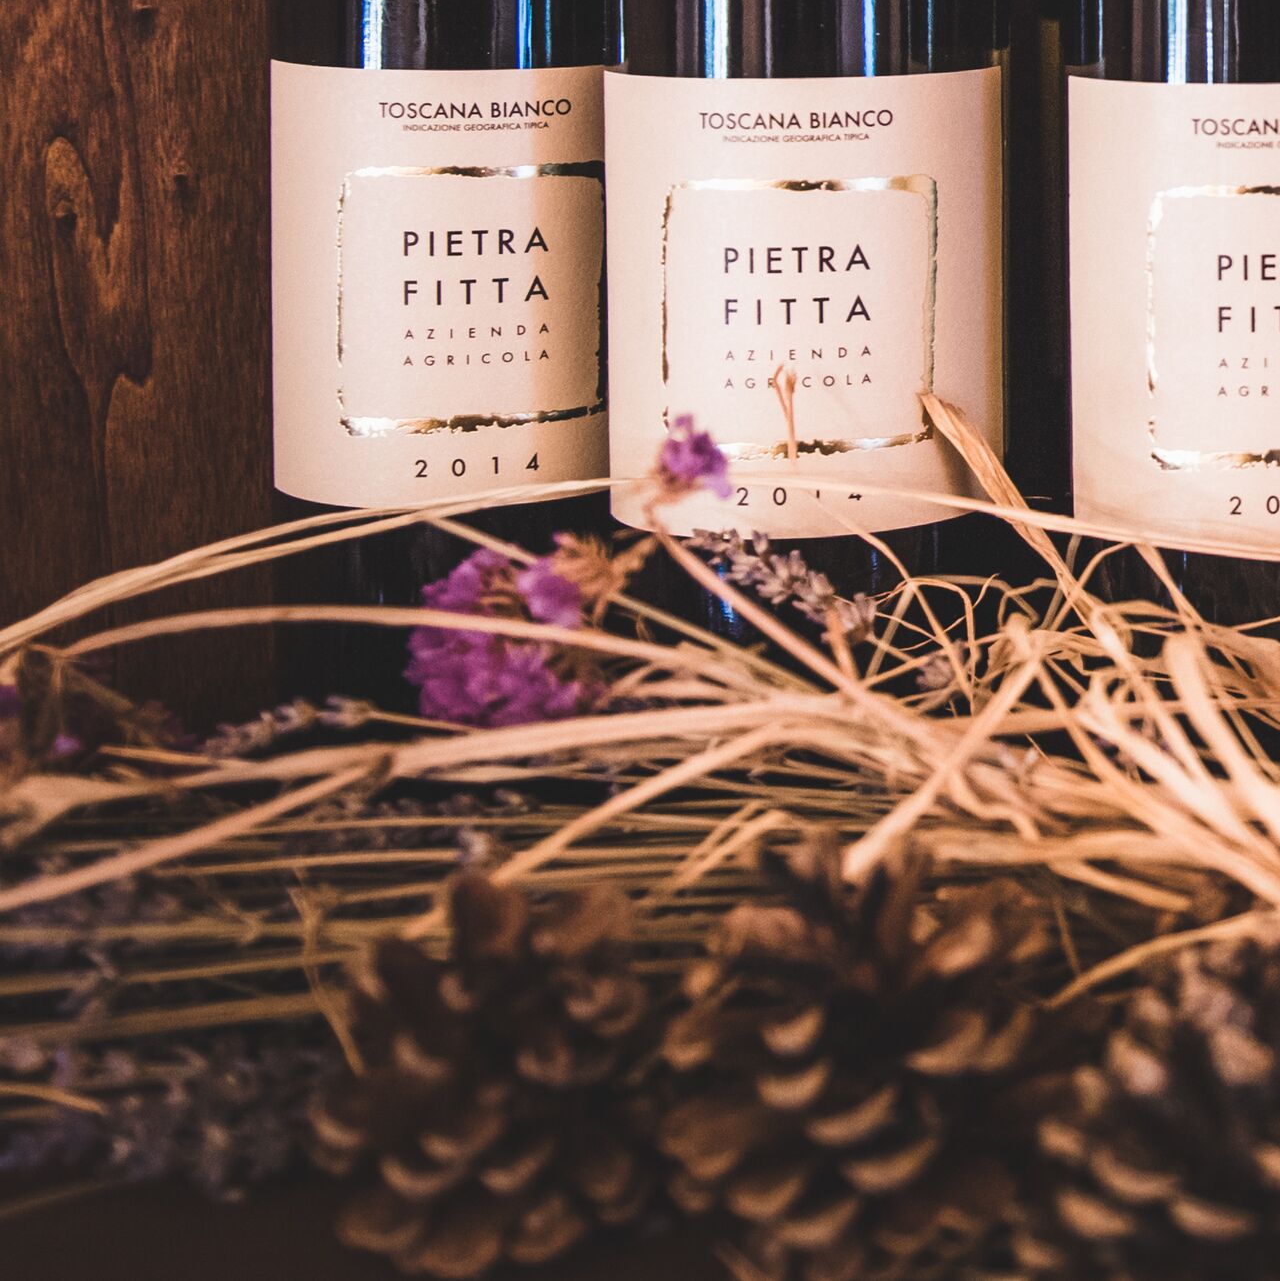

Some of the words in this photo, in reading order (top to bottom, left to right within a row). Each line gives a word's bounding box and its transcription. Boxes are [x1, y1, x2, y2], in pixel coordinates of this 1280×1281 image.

[379, 102, 483, 119] TOSCANA
[490, 98, 572, 117] BIANCO
[699, 113, 802, 129] TOSCANA
[809, 109, 893, 129] BIANCO
[403, 124, 461, 132] INDICAZIONE
[464, 123, 521, 131] GEOGRAFICA
[524, 121, 549, 129] TIPICA
[403, 227, 550, 256] PIETRA
[723, 243, 871, 274] PIETRA
[404, 275, 550, 306] FITTA
[724, 294, 871, 325] FITTA
[404, 323, 550, 340] AZIENDA
[403, 350, 550, 367] AGRICOLA
[725, 345, 872, 361] AZIENDA
[415, 452, 540, 478] 2014
